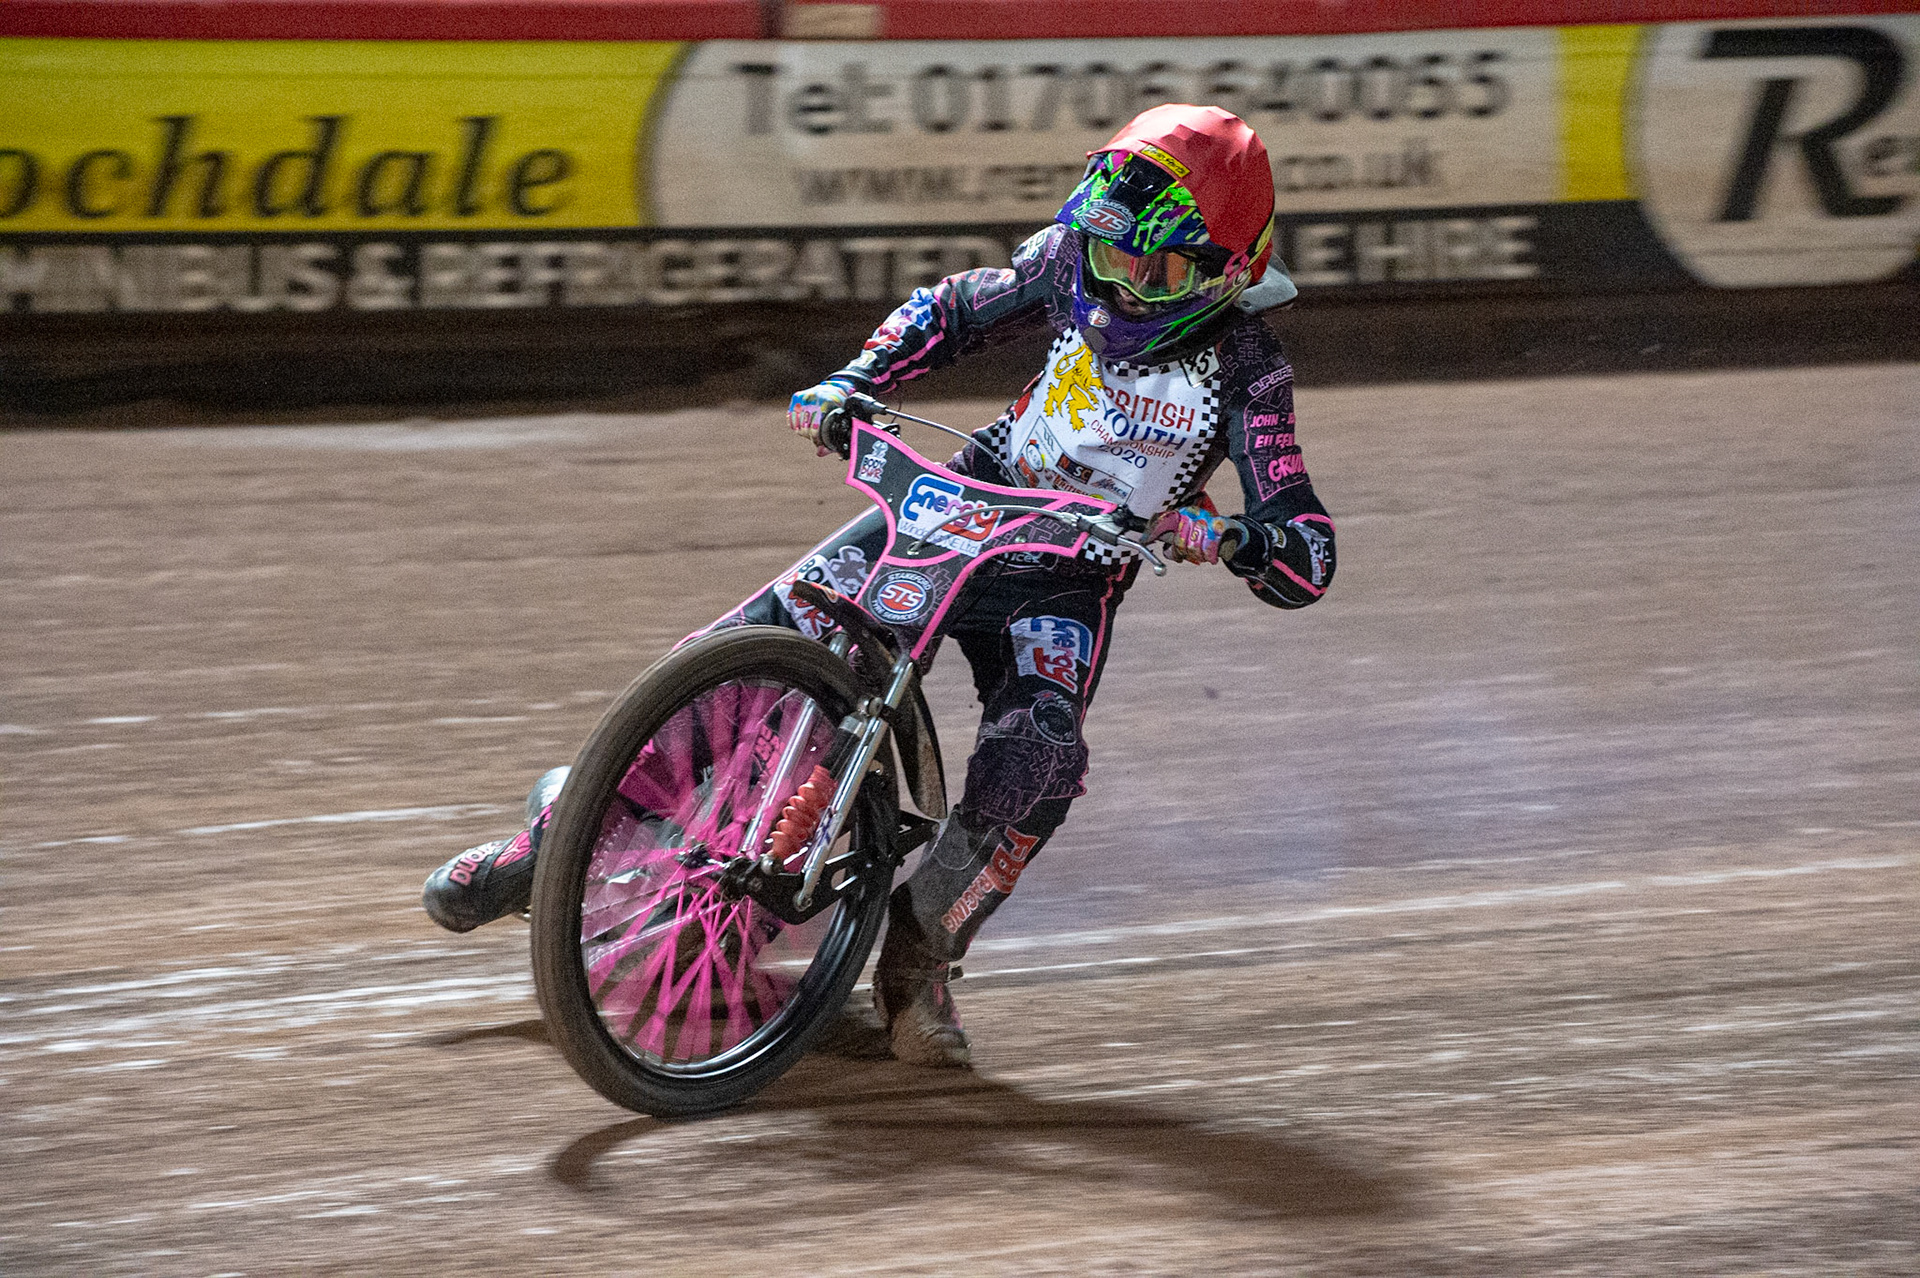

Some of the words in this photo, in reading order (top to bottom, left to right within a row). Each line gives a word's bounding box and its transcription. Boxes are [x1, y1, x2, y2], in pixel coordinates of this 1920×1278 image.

[0, 114, 573, 221] ochdale
[1084, 208, 1129, 231] STS
[1185, 350, 1213, 375] 45
[1102, 399, 1187, 450] YOUTH
[1091, 419, 1175, 459] CHAMONSHIP
[1098, 444, 1148, 469] 2020
[903, 475, 1000, 542] Energy
[888, 572, 932, 591] STAKEFORD
[879, 585, 924, 607] STS
